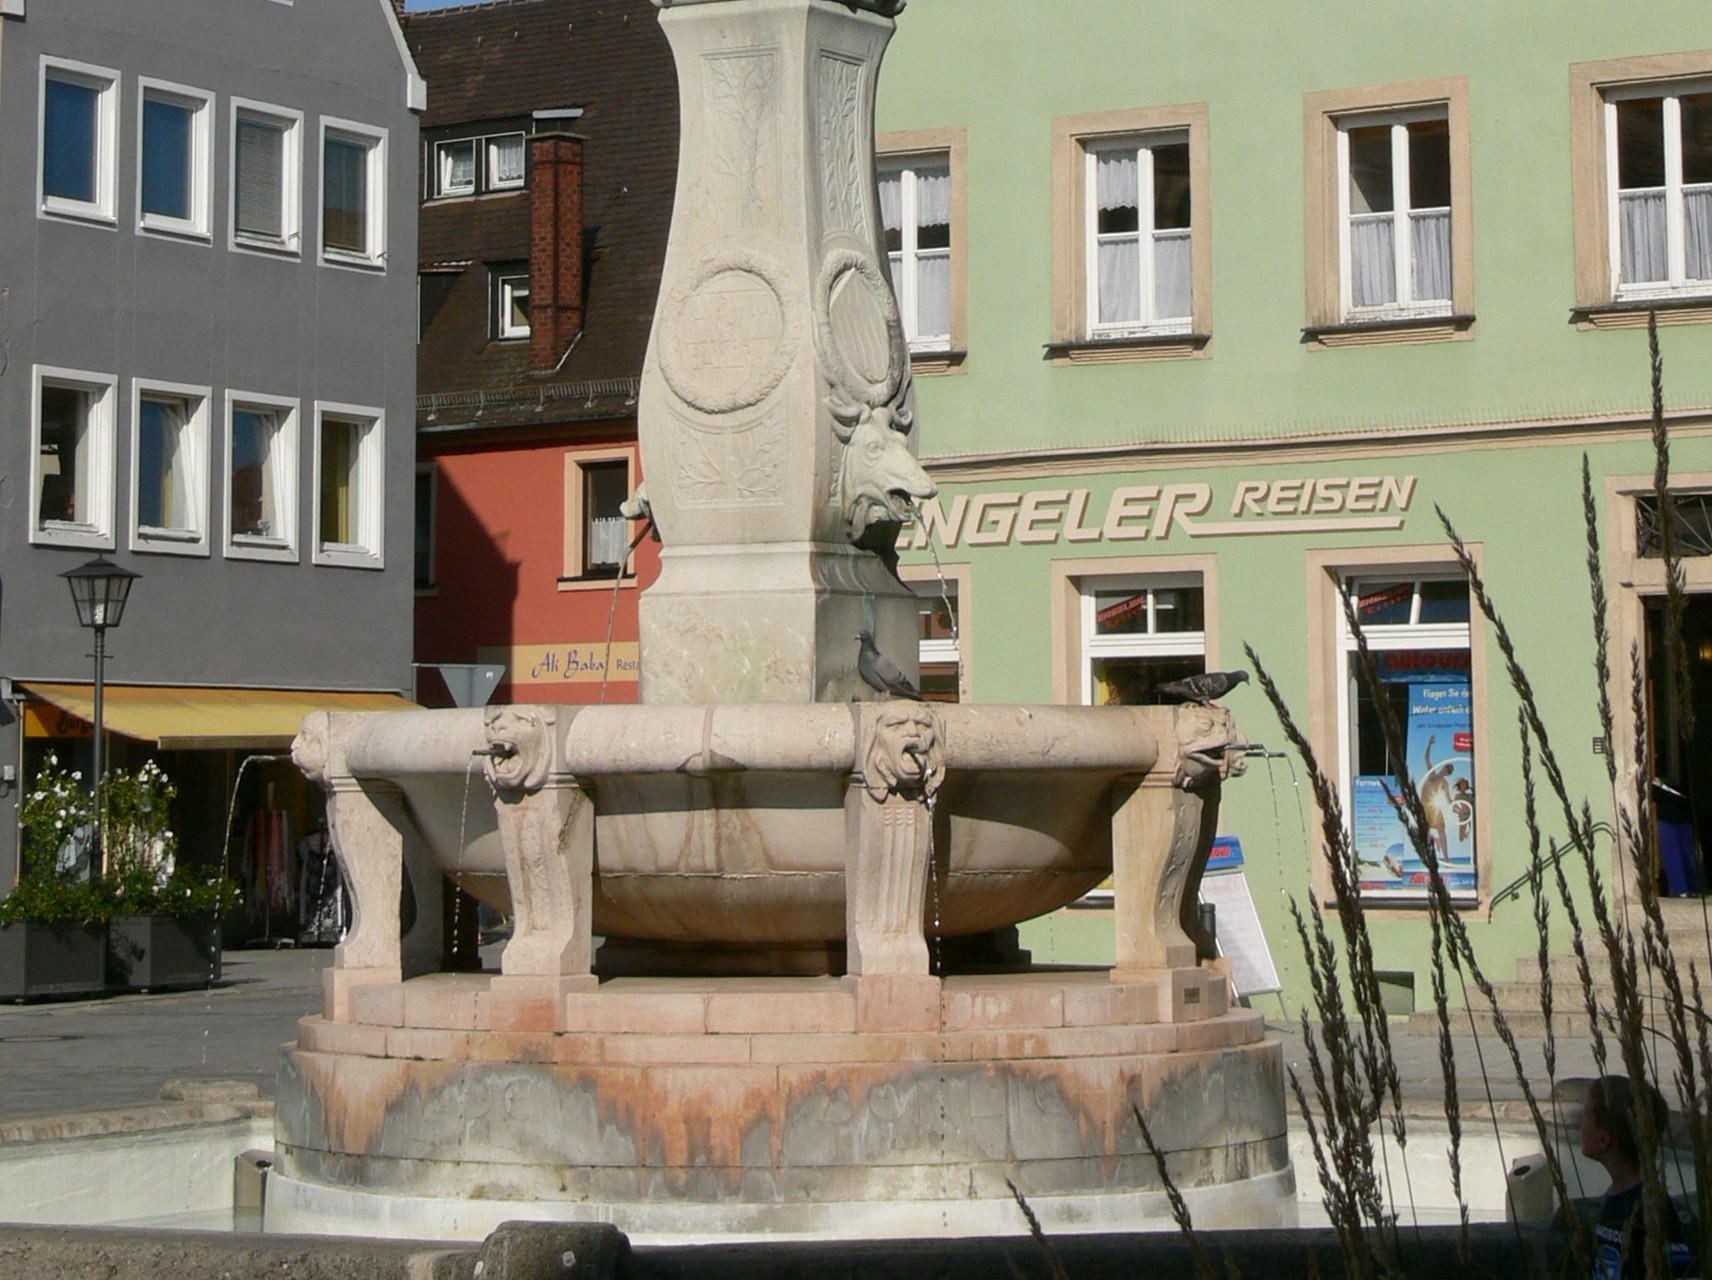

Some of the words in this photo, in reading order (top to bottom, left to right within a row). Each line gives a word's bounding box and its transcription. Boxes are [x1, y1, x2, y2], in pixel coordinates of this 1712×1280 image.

[1230, 474, 1419, 516] REISEN
[531, 651, 560, 679] Ali
[563, 648, 605, 679] Baba
